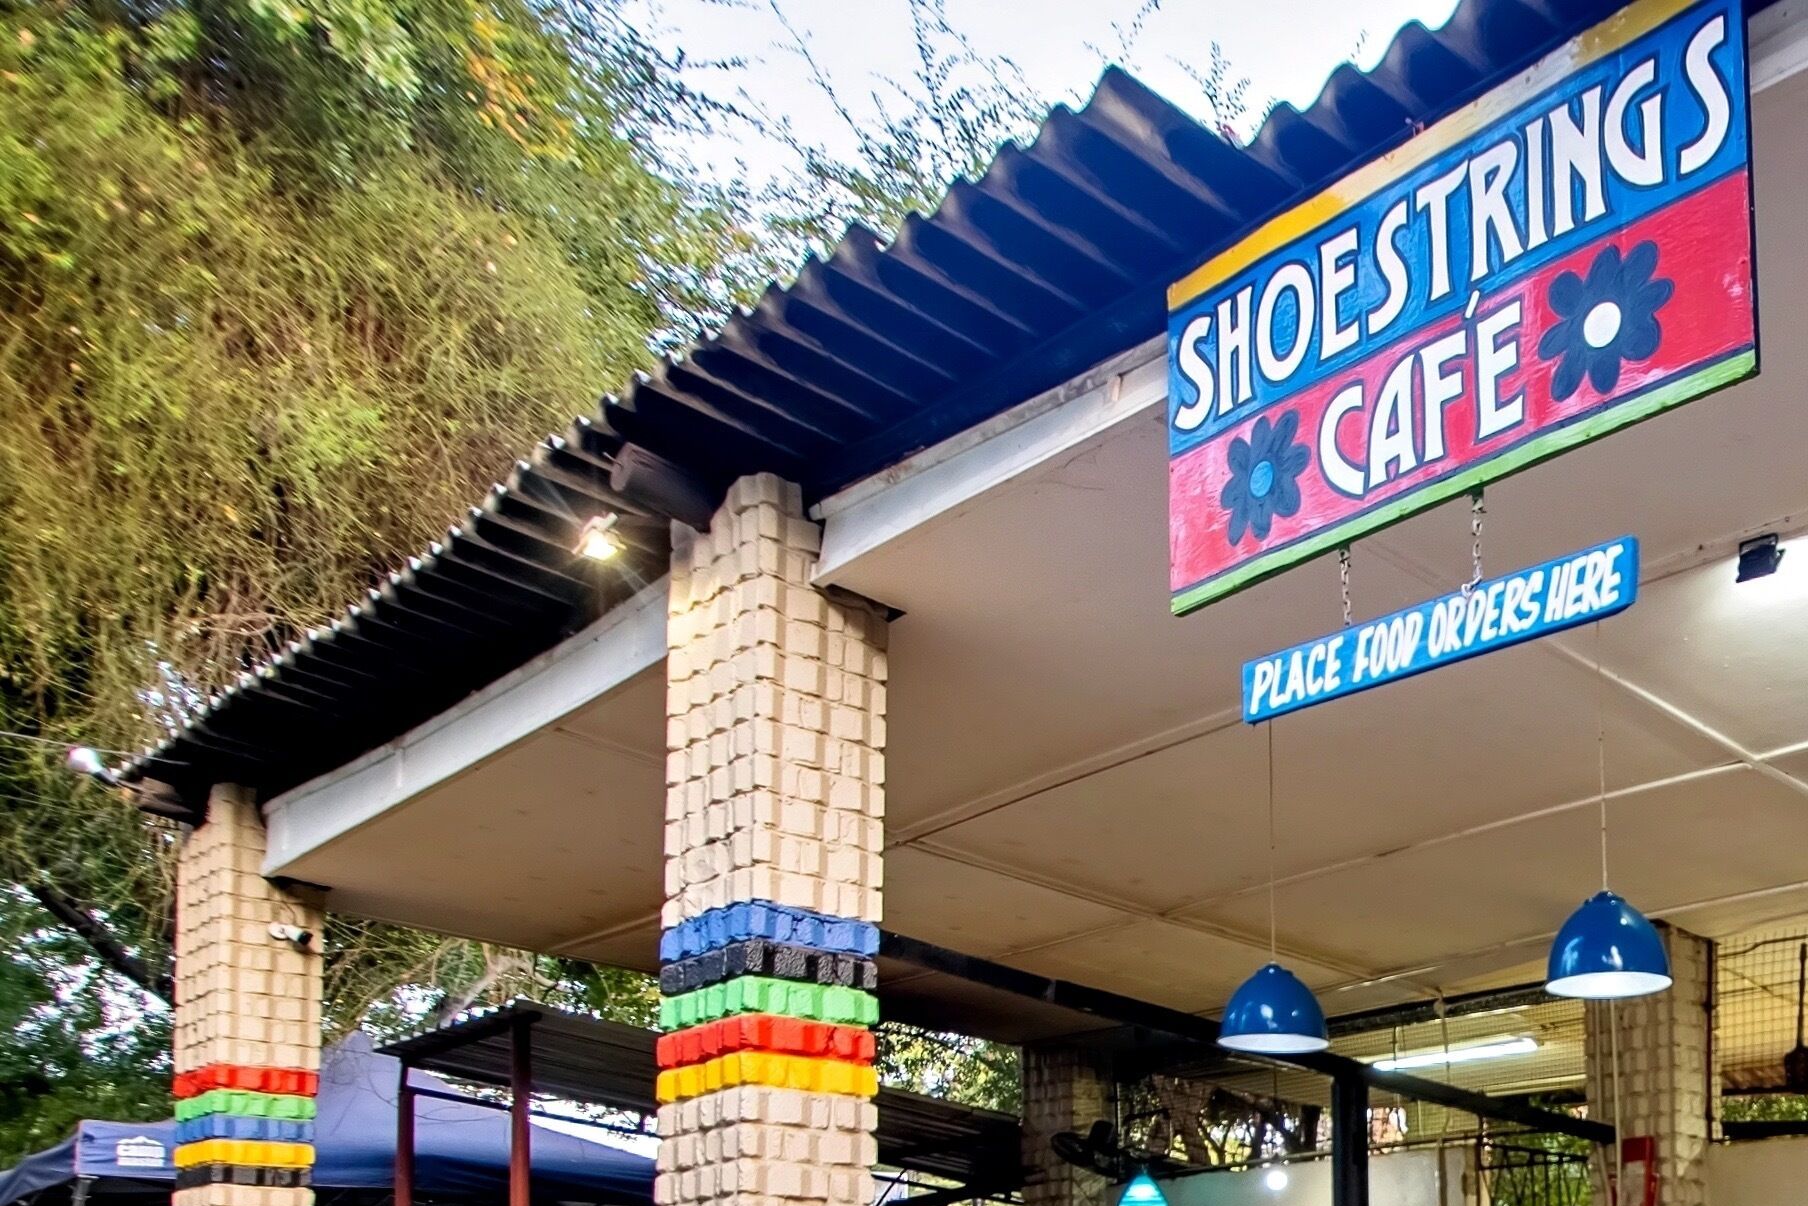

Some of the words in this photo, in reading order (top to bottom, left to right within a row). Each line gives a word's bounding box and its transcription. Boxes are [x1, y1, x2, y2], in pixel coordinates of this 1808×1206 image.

[1173, 12, 1733, 432] SHOESTRINGS
[1318, 289, 1525, 497] CAFÉ
[1249, 630, 1346, 715] PLACE
[1352, 609, 1424, 683] FOOD
[1427, 577, 1545, 657] ORDERS
[1543, 542, 1626, 622] HERE
